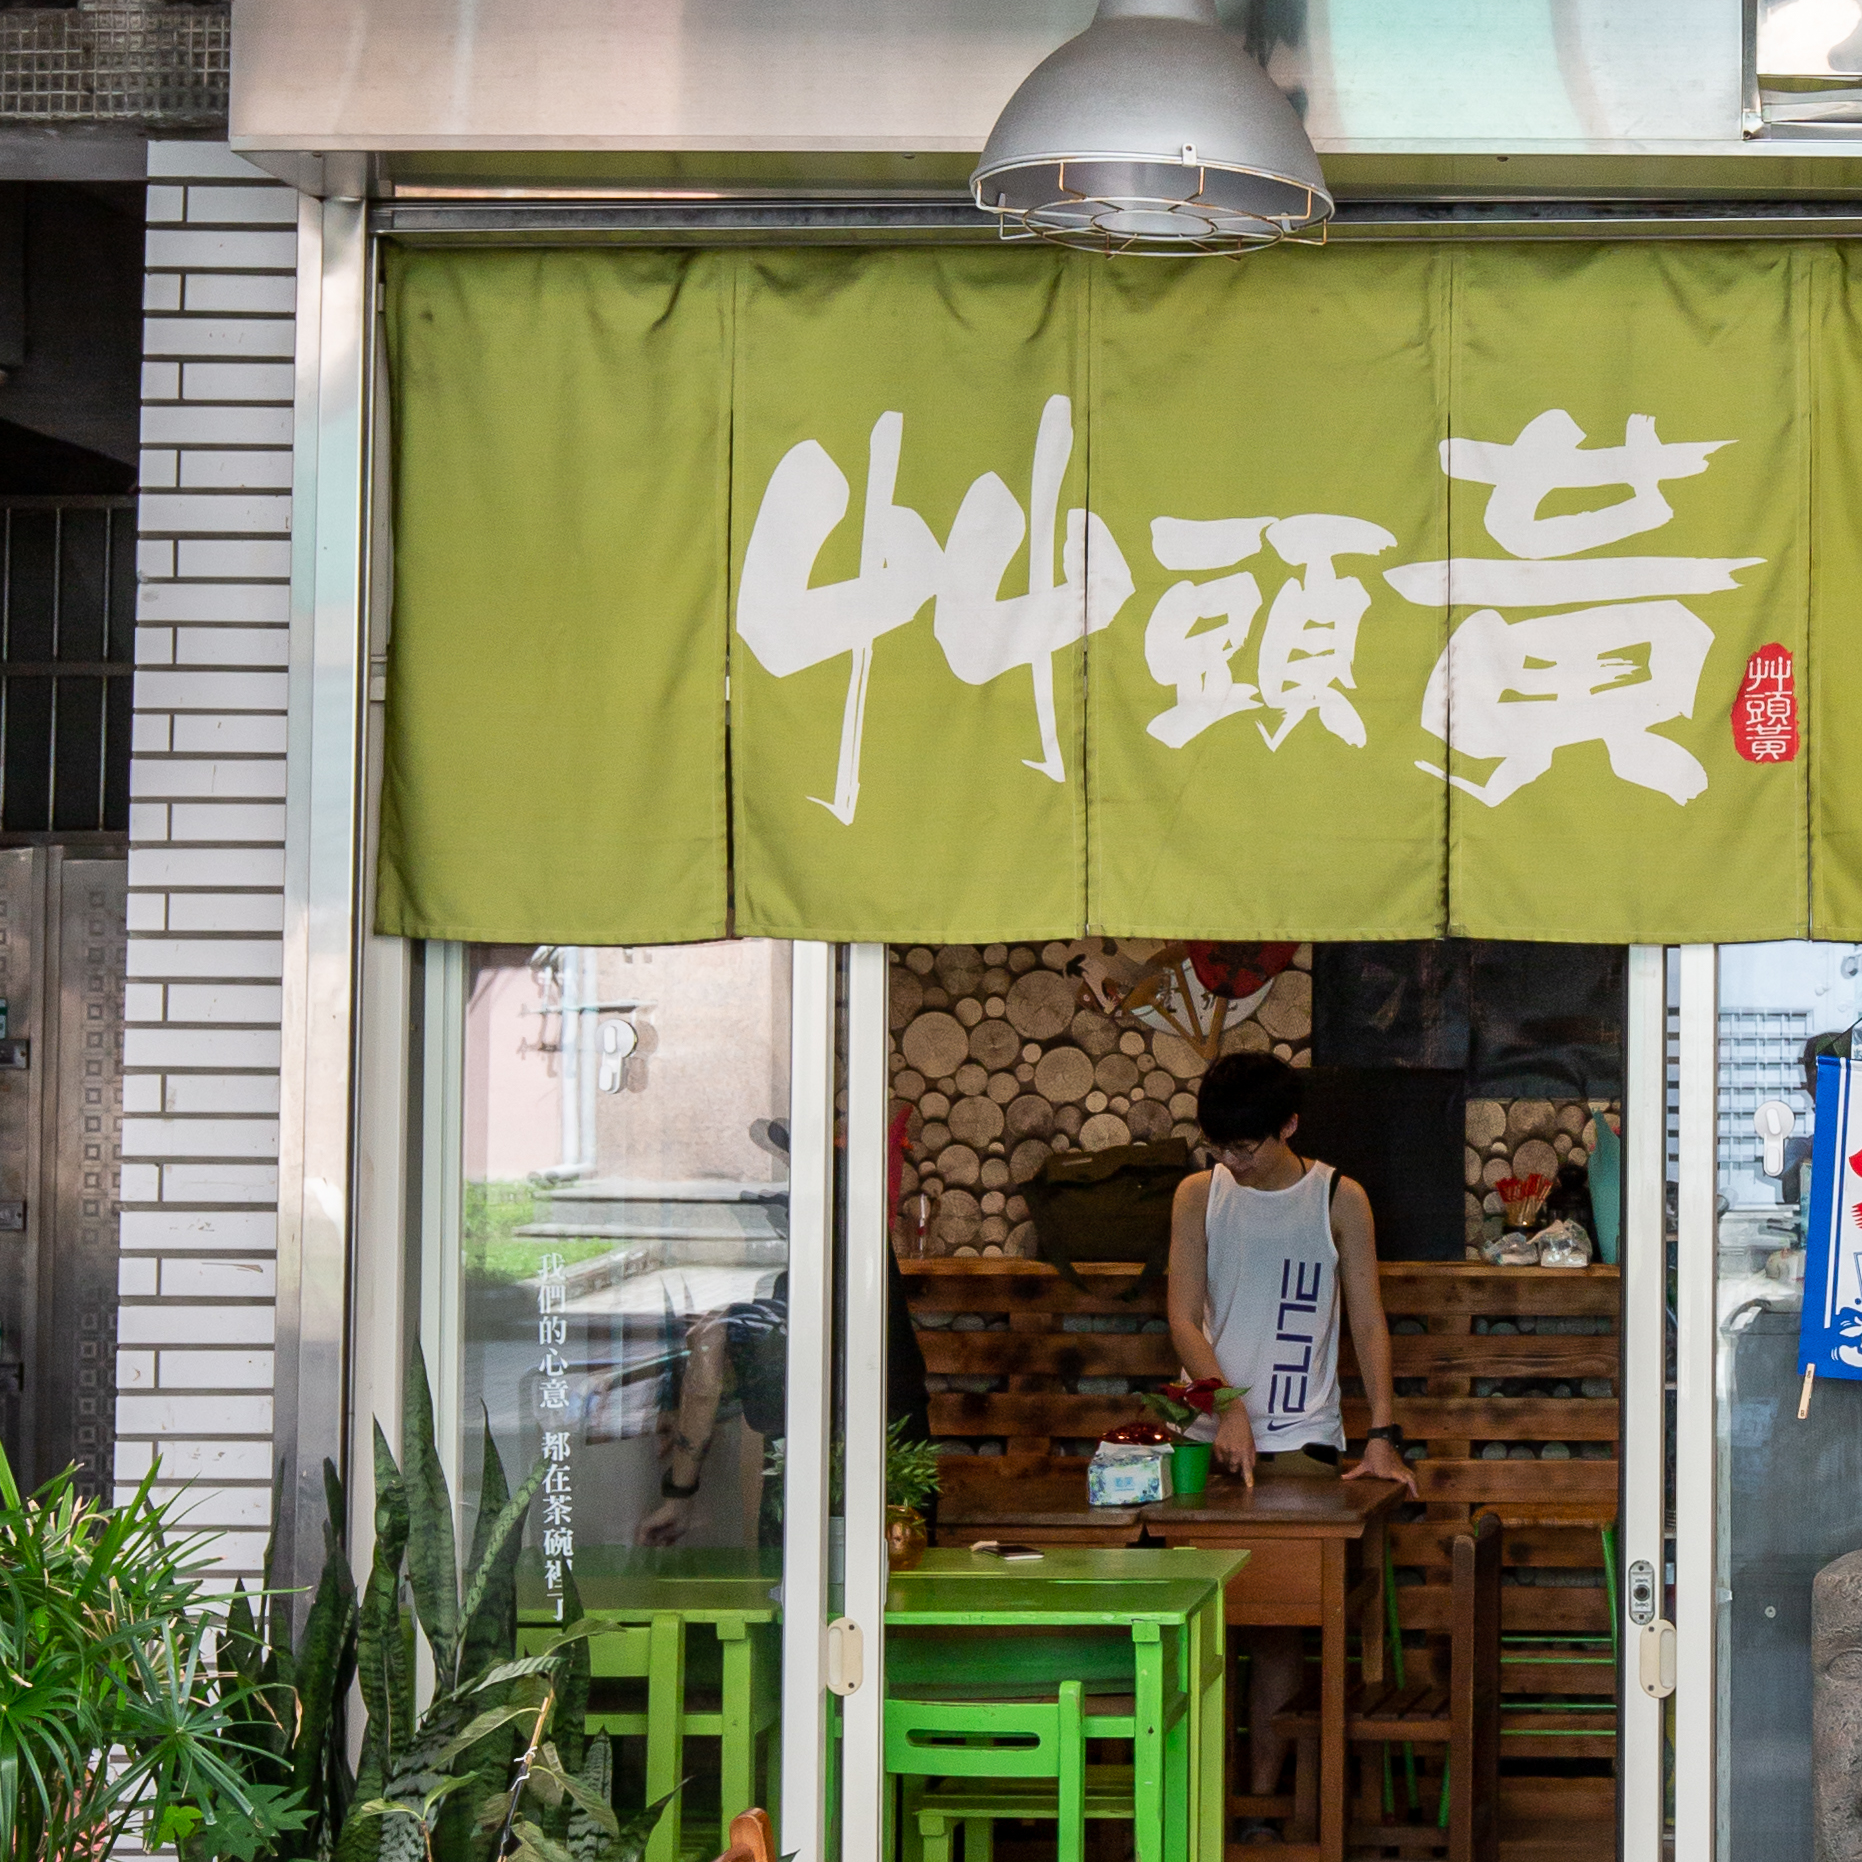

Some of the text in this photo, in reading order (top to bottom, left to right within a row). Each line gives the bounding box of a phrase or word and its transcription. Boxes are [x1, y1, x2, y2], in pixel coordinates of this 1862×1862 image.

[537, 1252, 570, 1409] 我們的心意
[1267, 1258, 1322, 1415] ELITE
